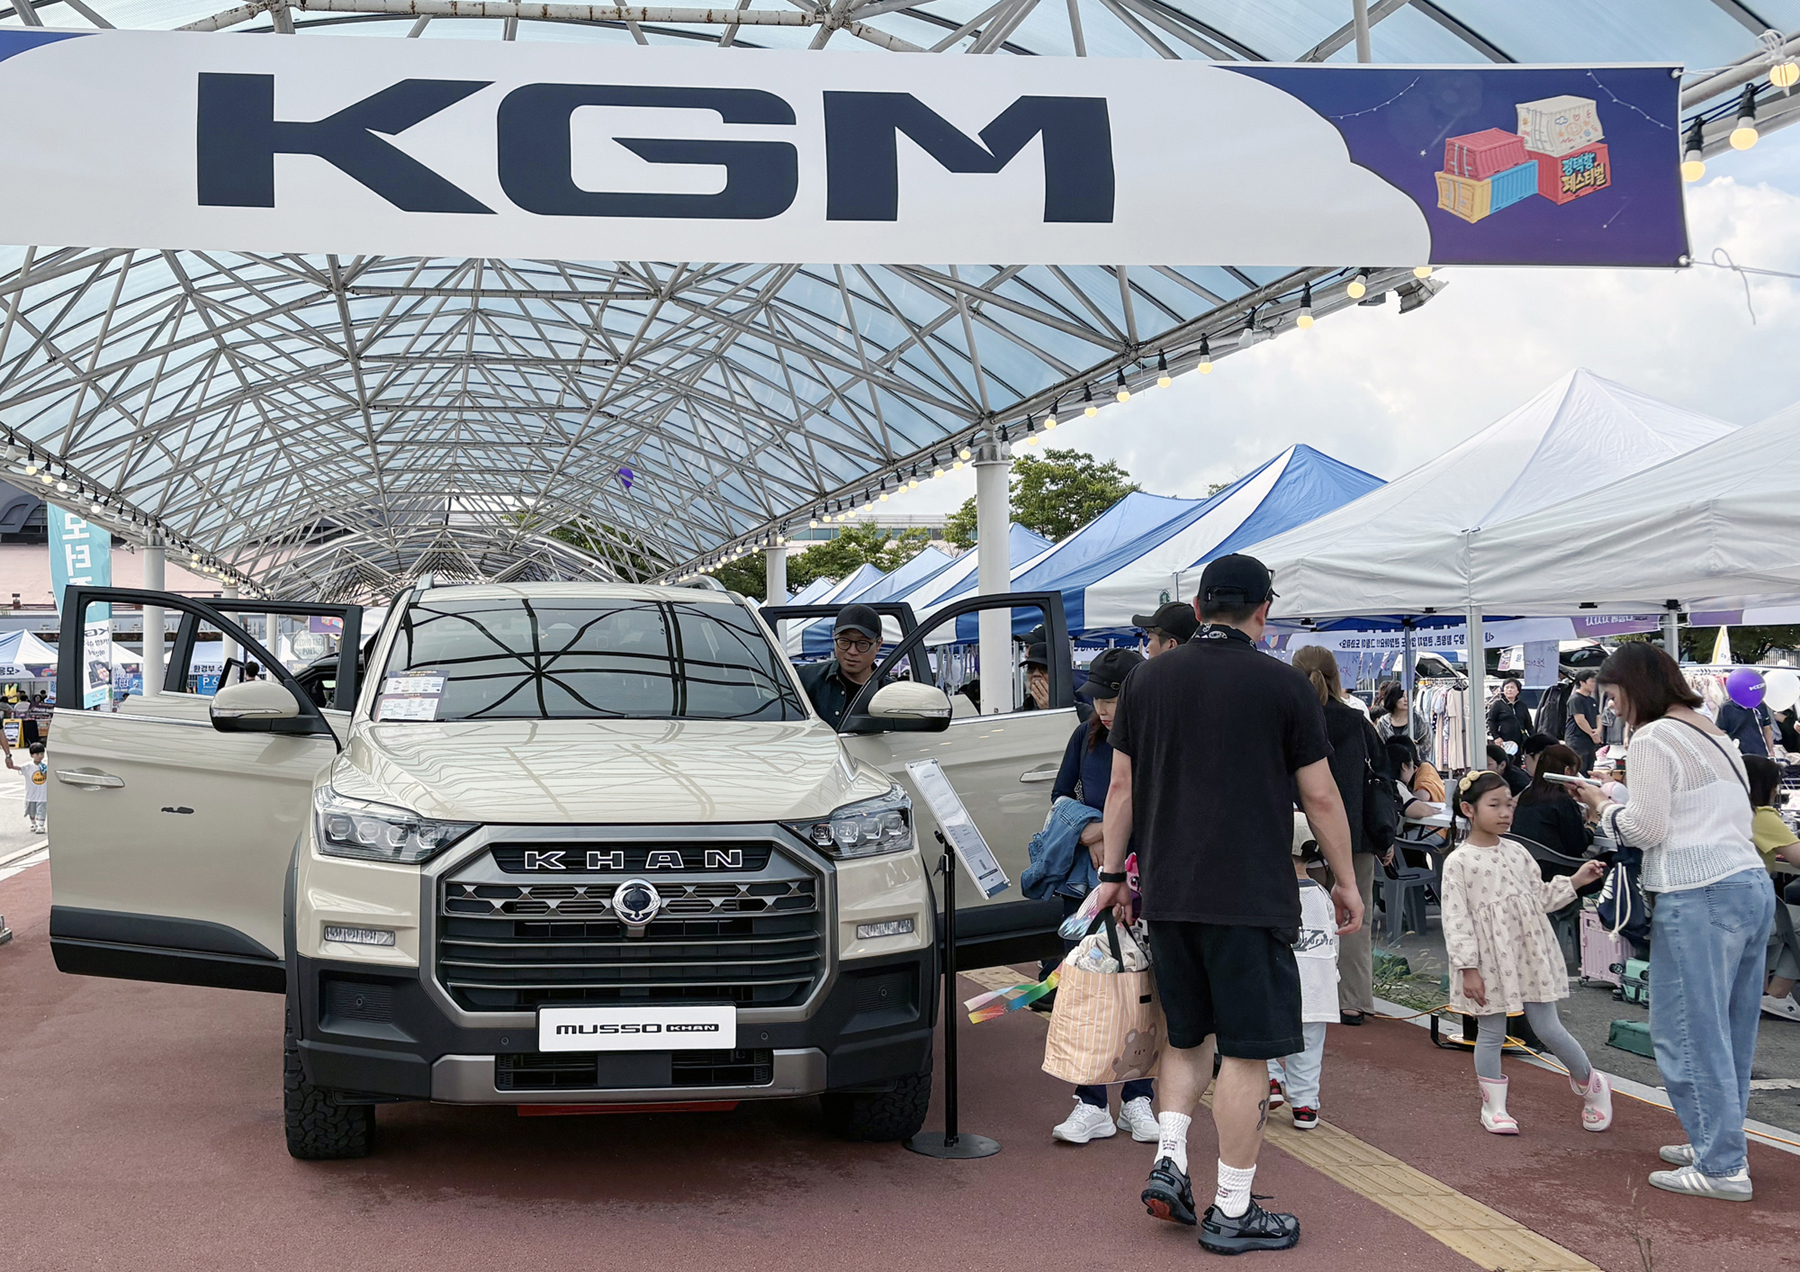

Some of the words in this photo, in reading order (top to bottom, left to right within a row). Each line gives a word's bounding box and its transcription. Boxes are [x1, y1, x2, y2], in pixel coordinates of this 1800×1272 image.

[198, 72, 1115, 223] KGM
[1562, 152, 1597, 176] 평택항
[1561, 162, 1607, 194] 페스티벌
[193, 664, 215, 673] 환경부
[524, 849, 743, 870] KHAN
[555, 1023, 662, 1035] MUSSO
[667, 1024, 719, 1033] KHAN
